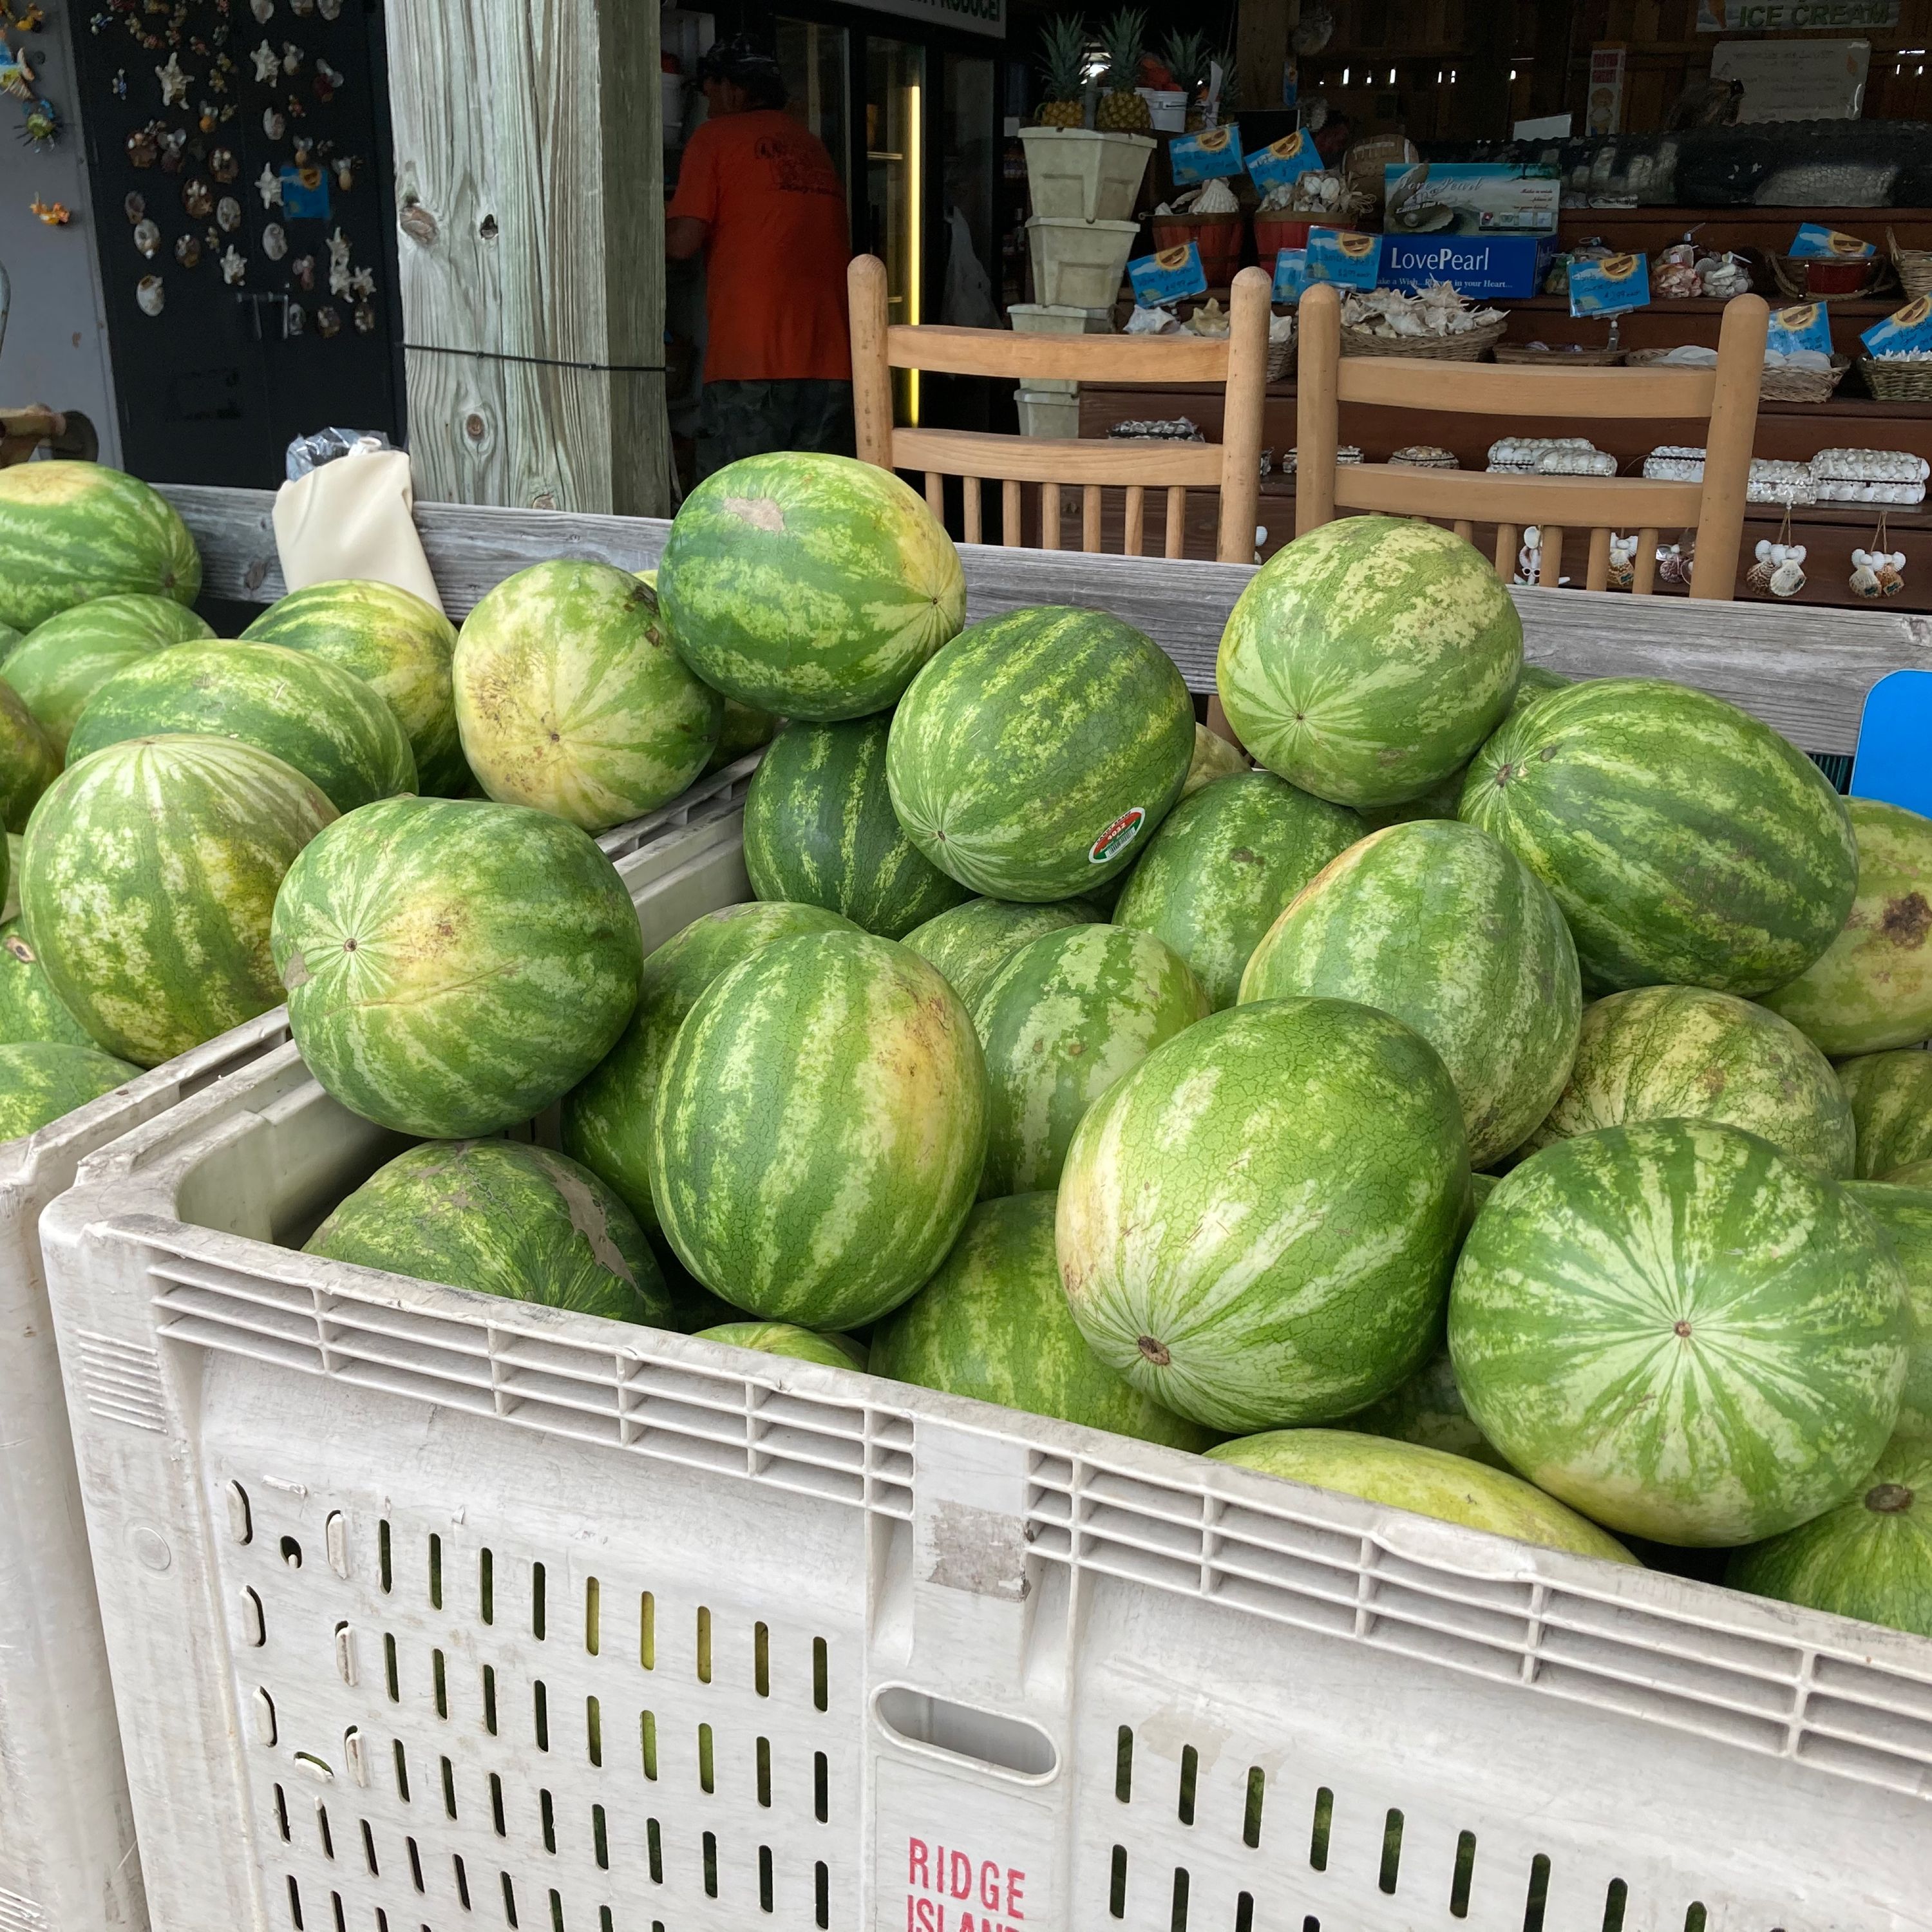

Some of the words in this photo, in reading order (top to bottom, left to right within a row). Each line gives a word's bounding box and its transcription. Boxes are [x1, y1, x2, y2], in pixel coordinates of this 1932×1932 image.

[1739, 5, 1783, 27] ICE
[1791, 3, 1890, 26] CREAM
[1391, 247, 1490, 271] LovePearl
[1378, 277, 1391, 285] ake
[1464, 281, 1482, 289] your
[1107, 822, 1126, 840] 4032
[909, 1837, 1025, 1919] RIDGE
[907, 1894, 1021, 1932] ISL
